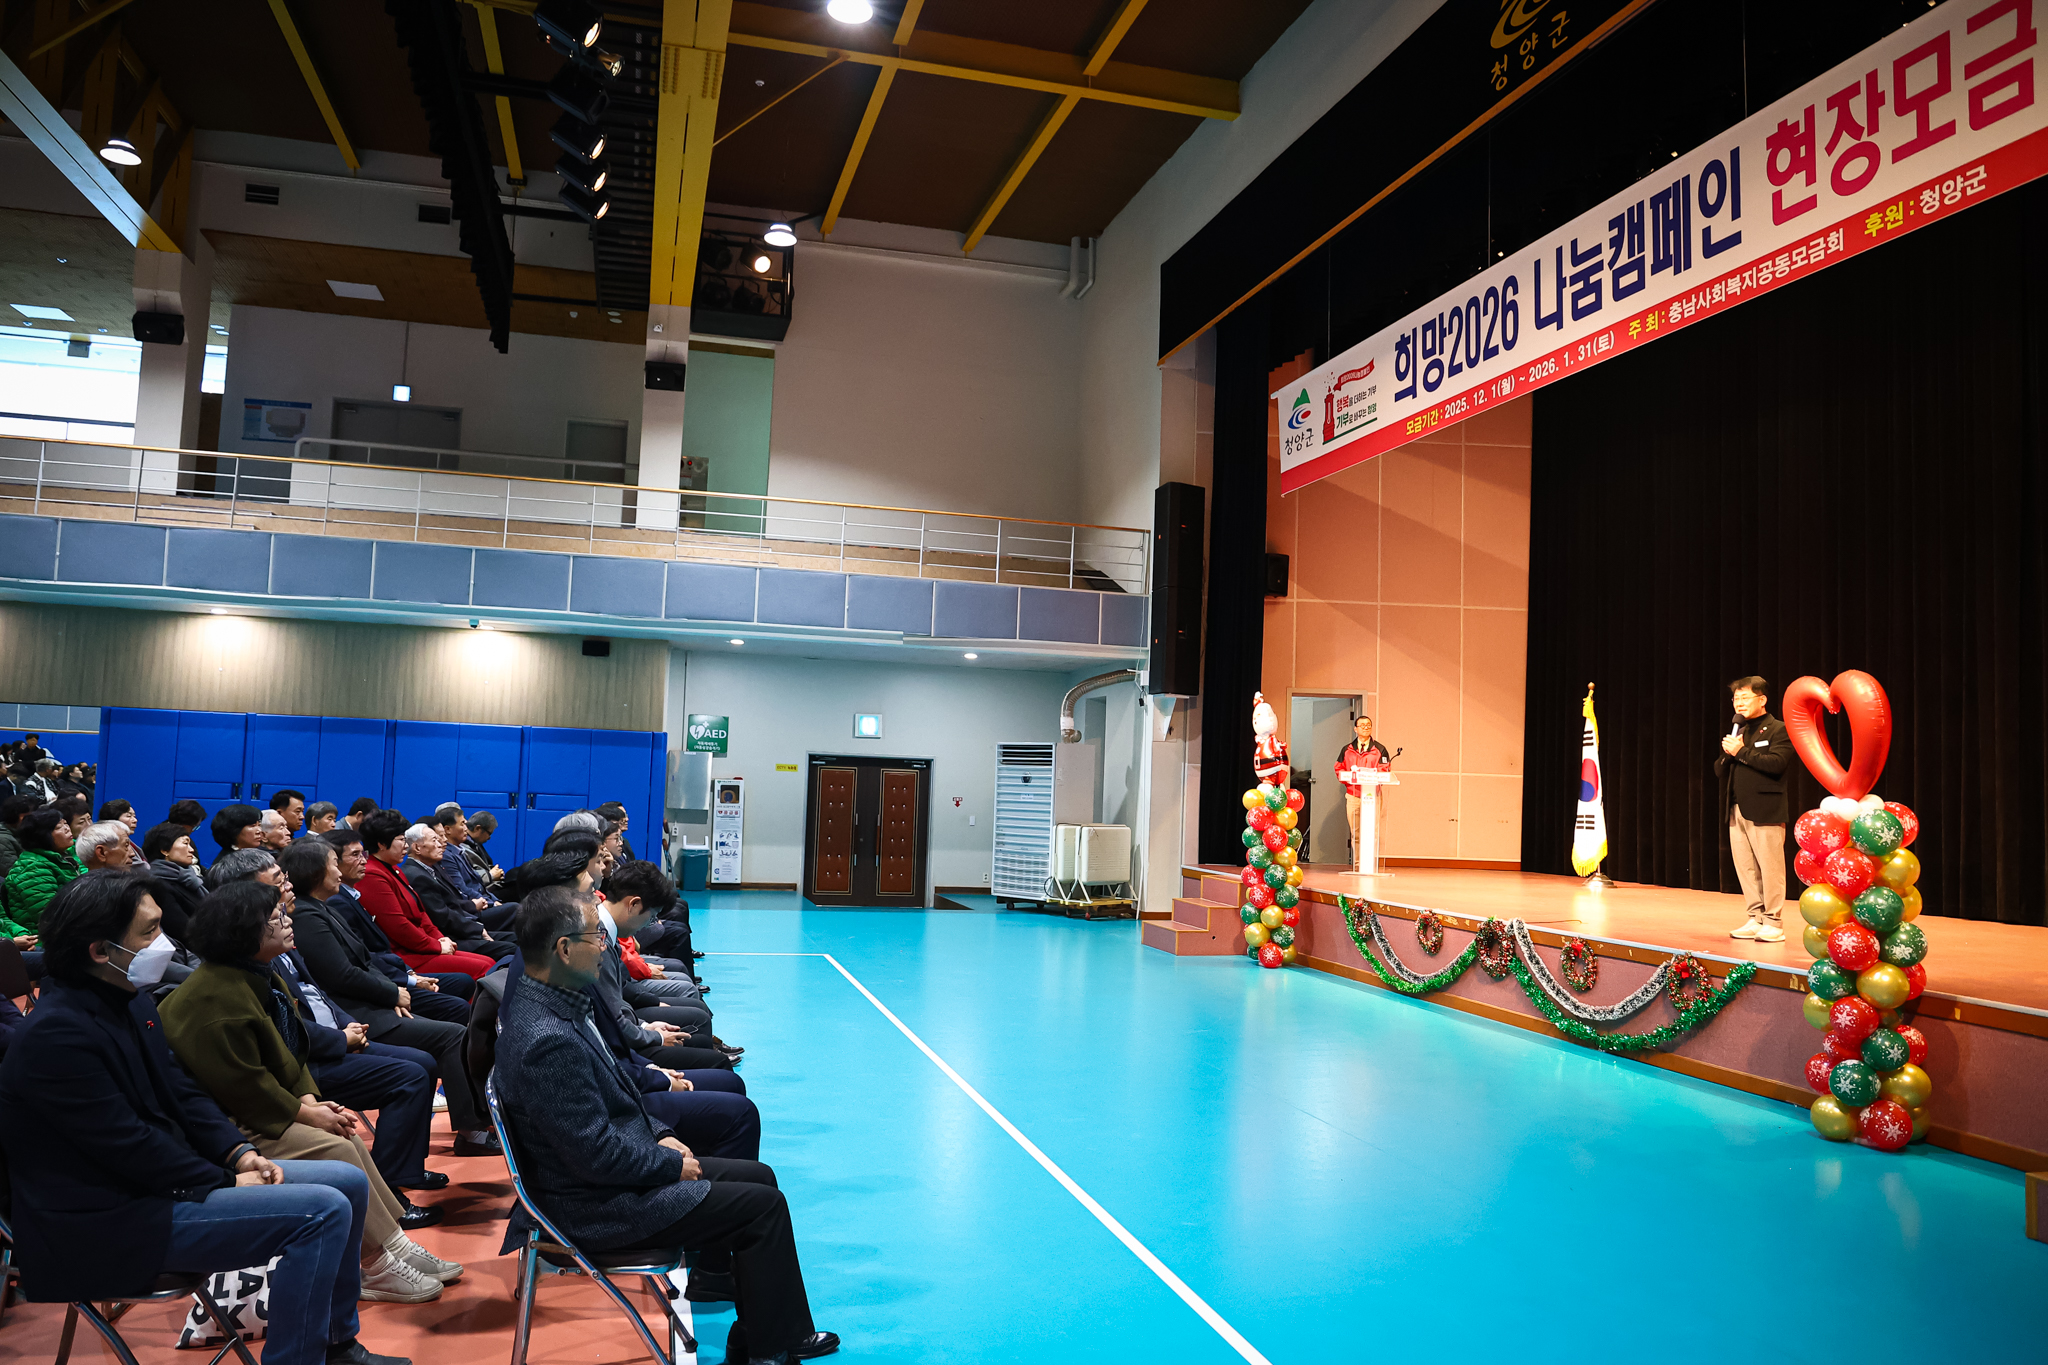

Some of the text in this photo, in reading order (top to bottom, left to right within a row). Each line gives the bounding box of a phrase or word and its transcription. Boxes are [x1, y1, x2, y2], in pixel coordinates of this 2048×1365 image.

[1490, 10, 1571, 91] 청양군
[1394, 0, 2037, 403] 희망2026 나눔캠페인 현장모금
[1577, 330, 1615, 361] 31(토)
[1668, 228, 1844, 324] 충남사회복지공동모금회
[1919, 164, 1987, 215] 청양군
[1284, 428, 1314, 455] 청양군
[704, 729, 727, 739] AED
